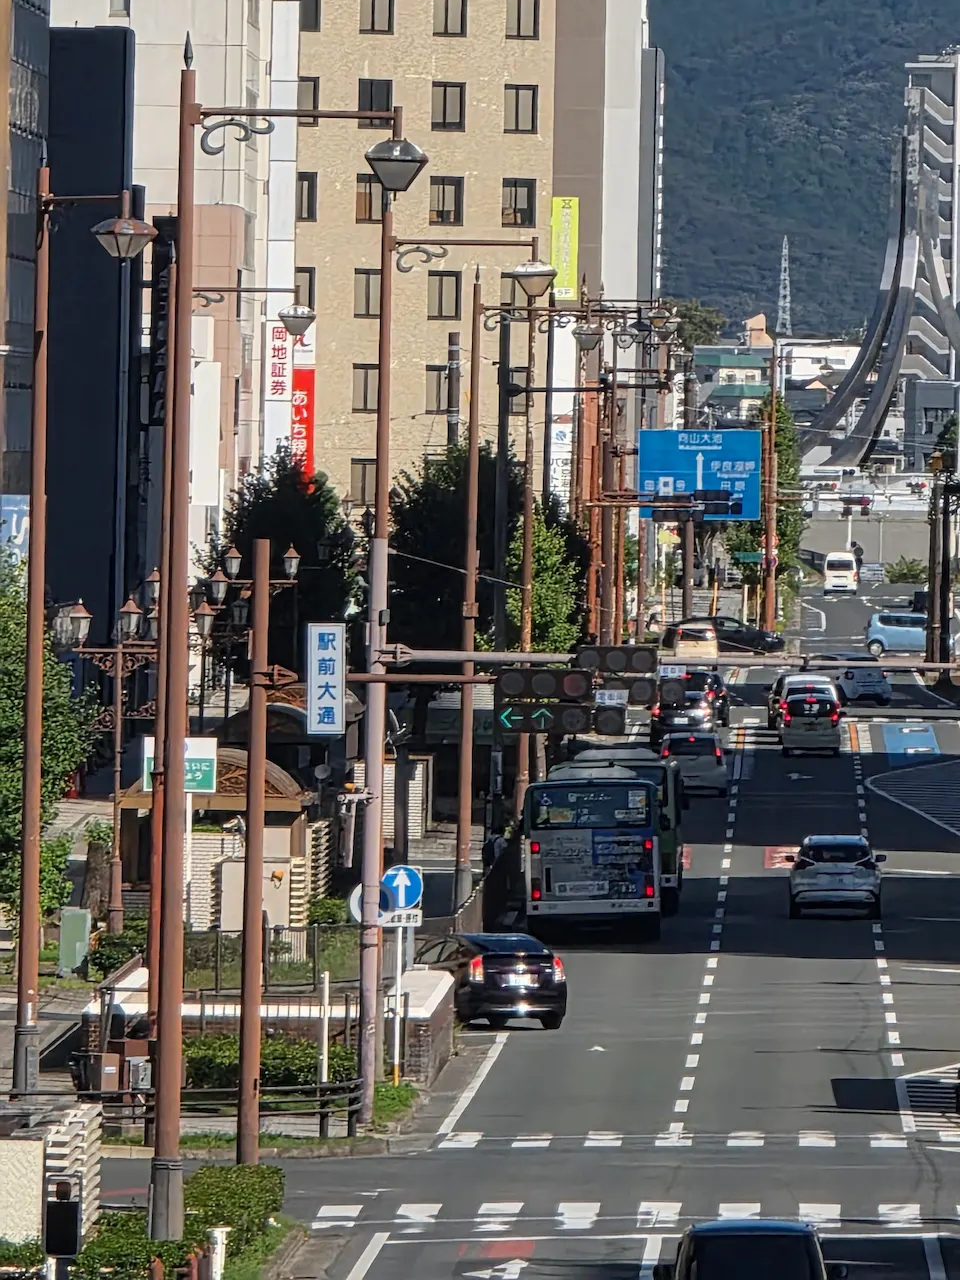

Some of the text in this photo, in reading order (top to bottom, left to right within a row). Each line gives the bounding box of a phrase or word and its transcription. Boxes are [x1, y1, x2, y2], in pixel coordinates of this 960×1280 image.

[271, 326, 287, 396] 岡地証券
[317, 632, 336, 725] 駅前大通
